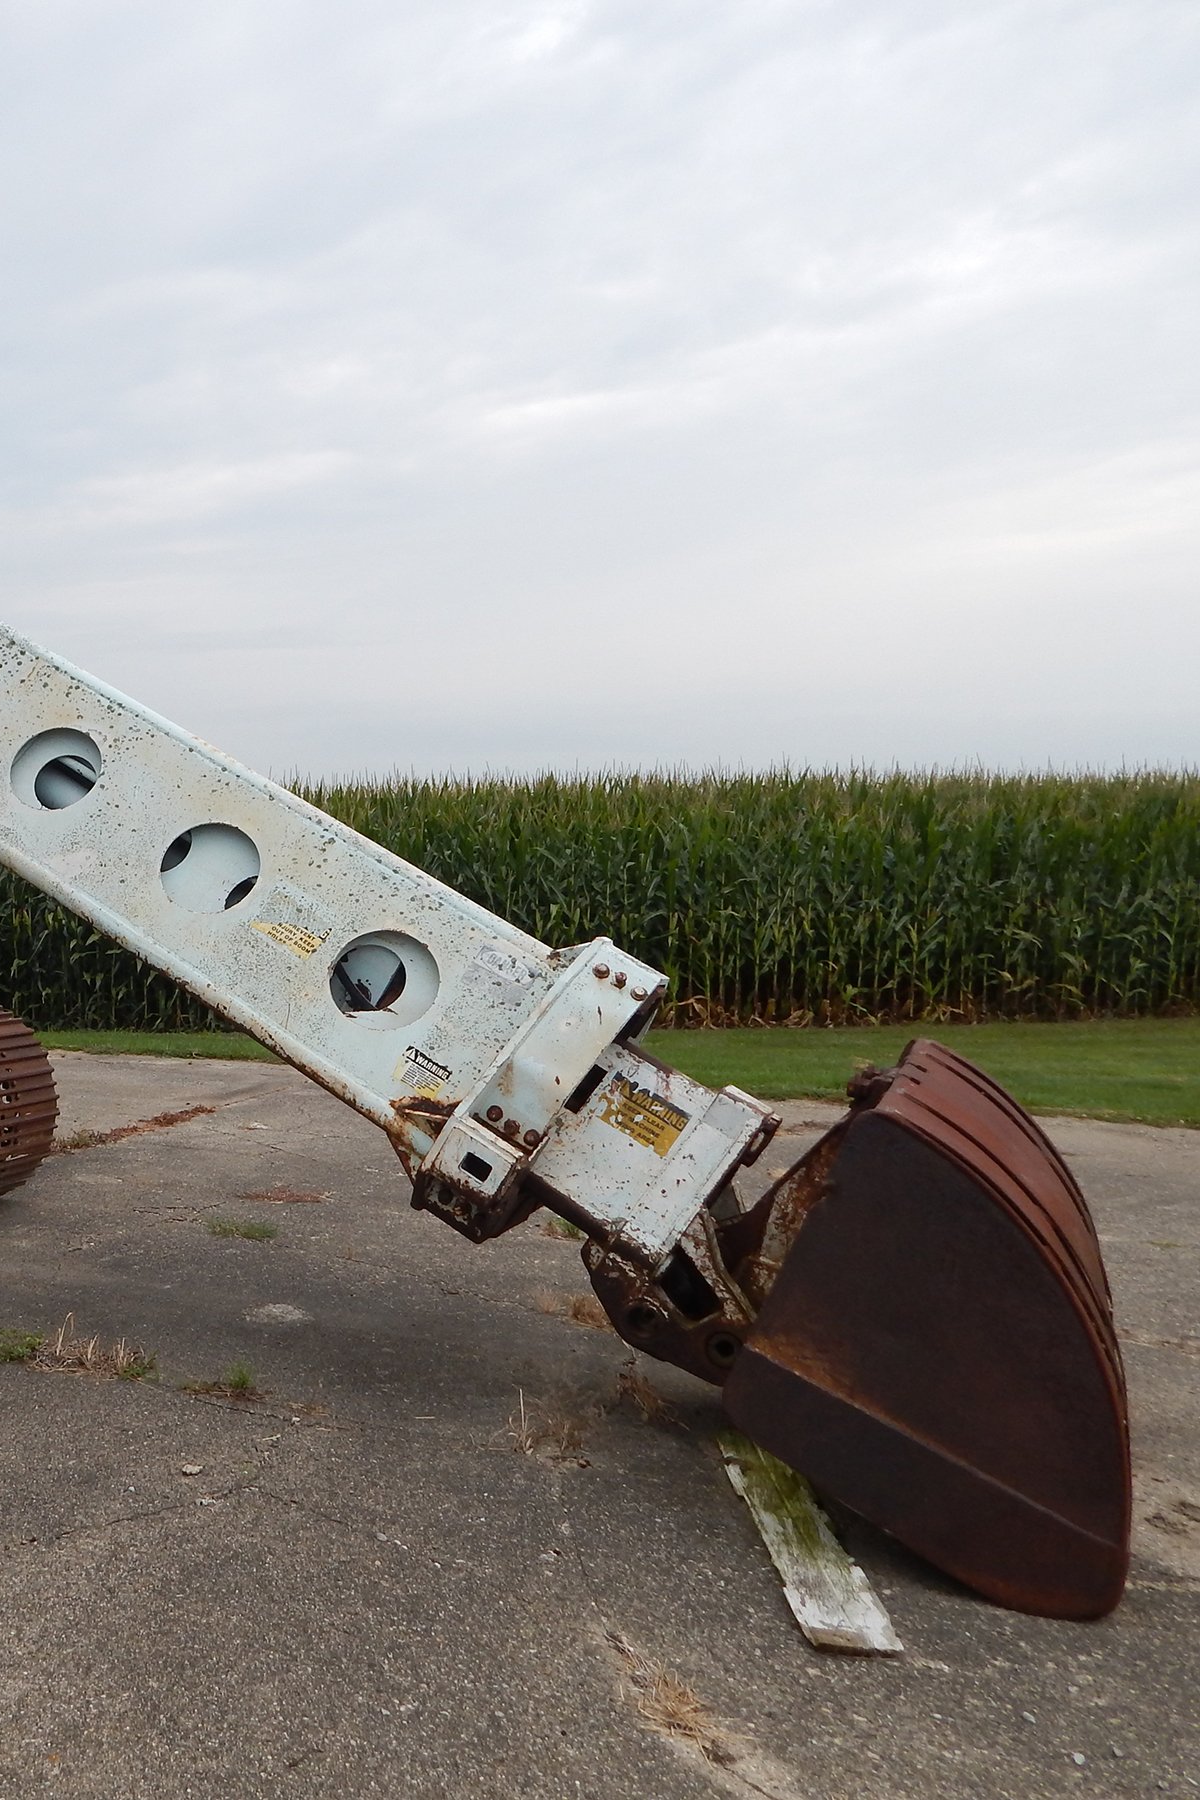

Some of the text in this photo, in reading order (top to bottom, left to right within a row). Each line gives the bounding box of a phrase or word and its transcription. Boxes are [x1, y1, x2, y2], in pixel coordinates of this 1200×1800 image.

[272, 926, 310, 954] OUT OF BOOM
[299, 937, 314, 948] KEEP
[416, 1054, 449, 1079] WARNING
[631, 1091, 688, 1129] WARNING
[642, 1114, 666, 1132] CLEAR
[636, 1132, 655, 1145] AREA
